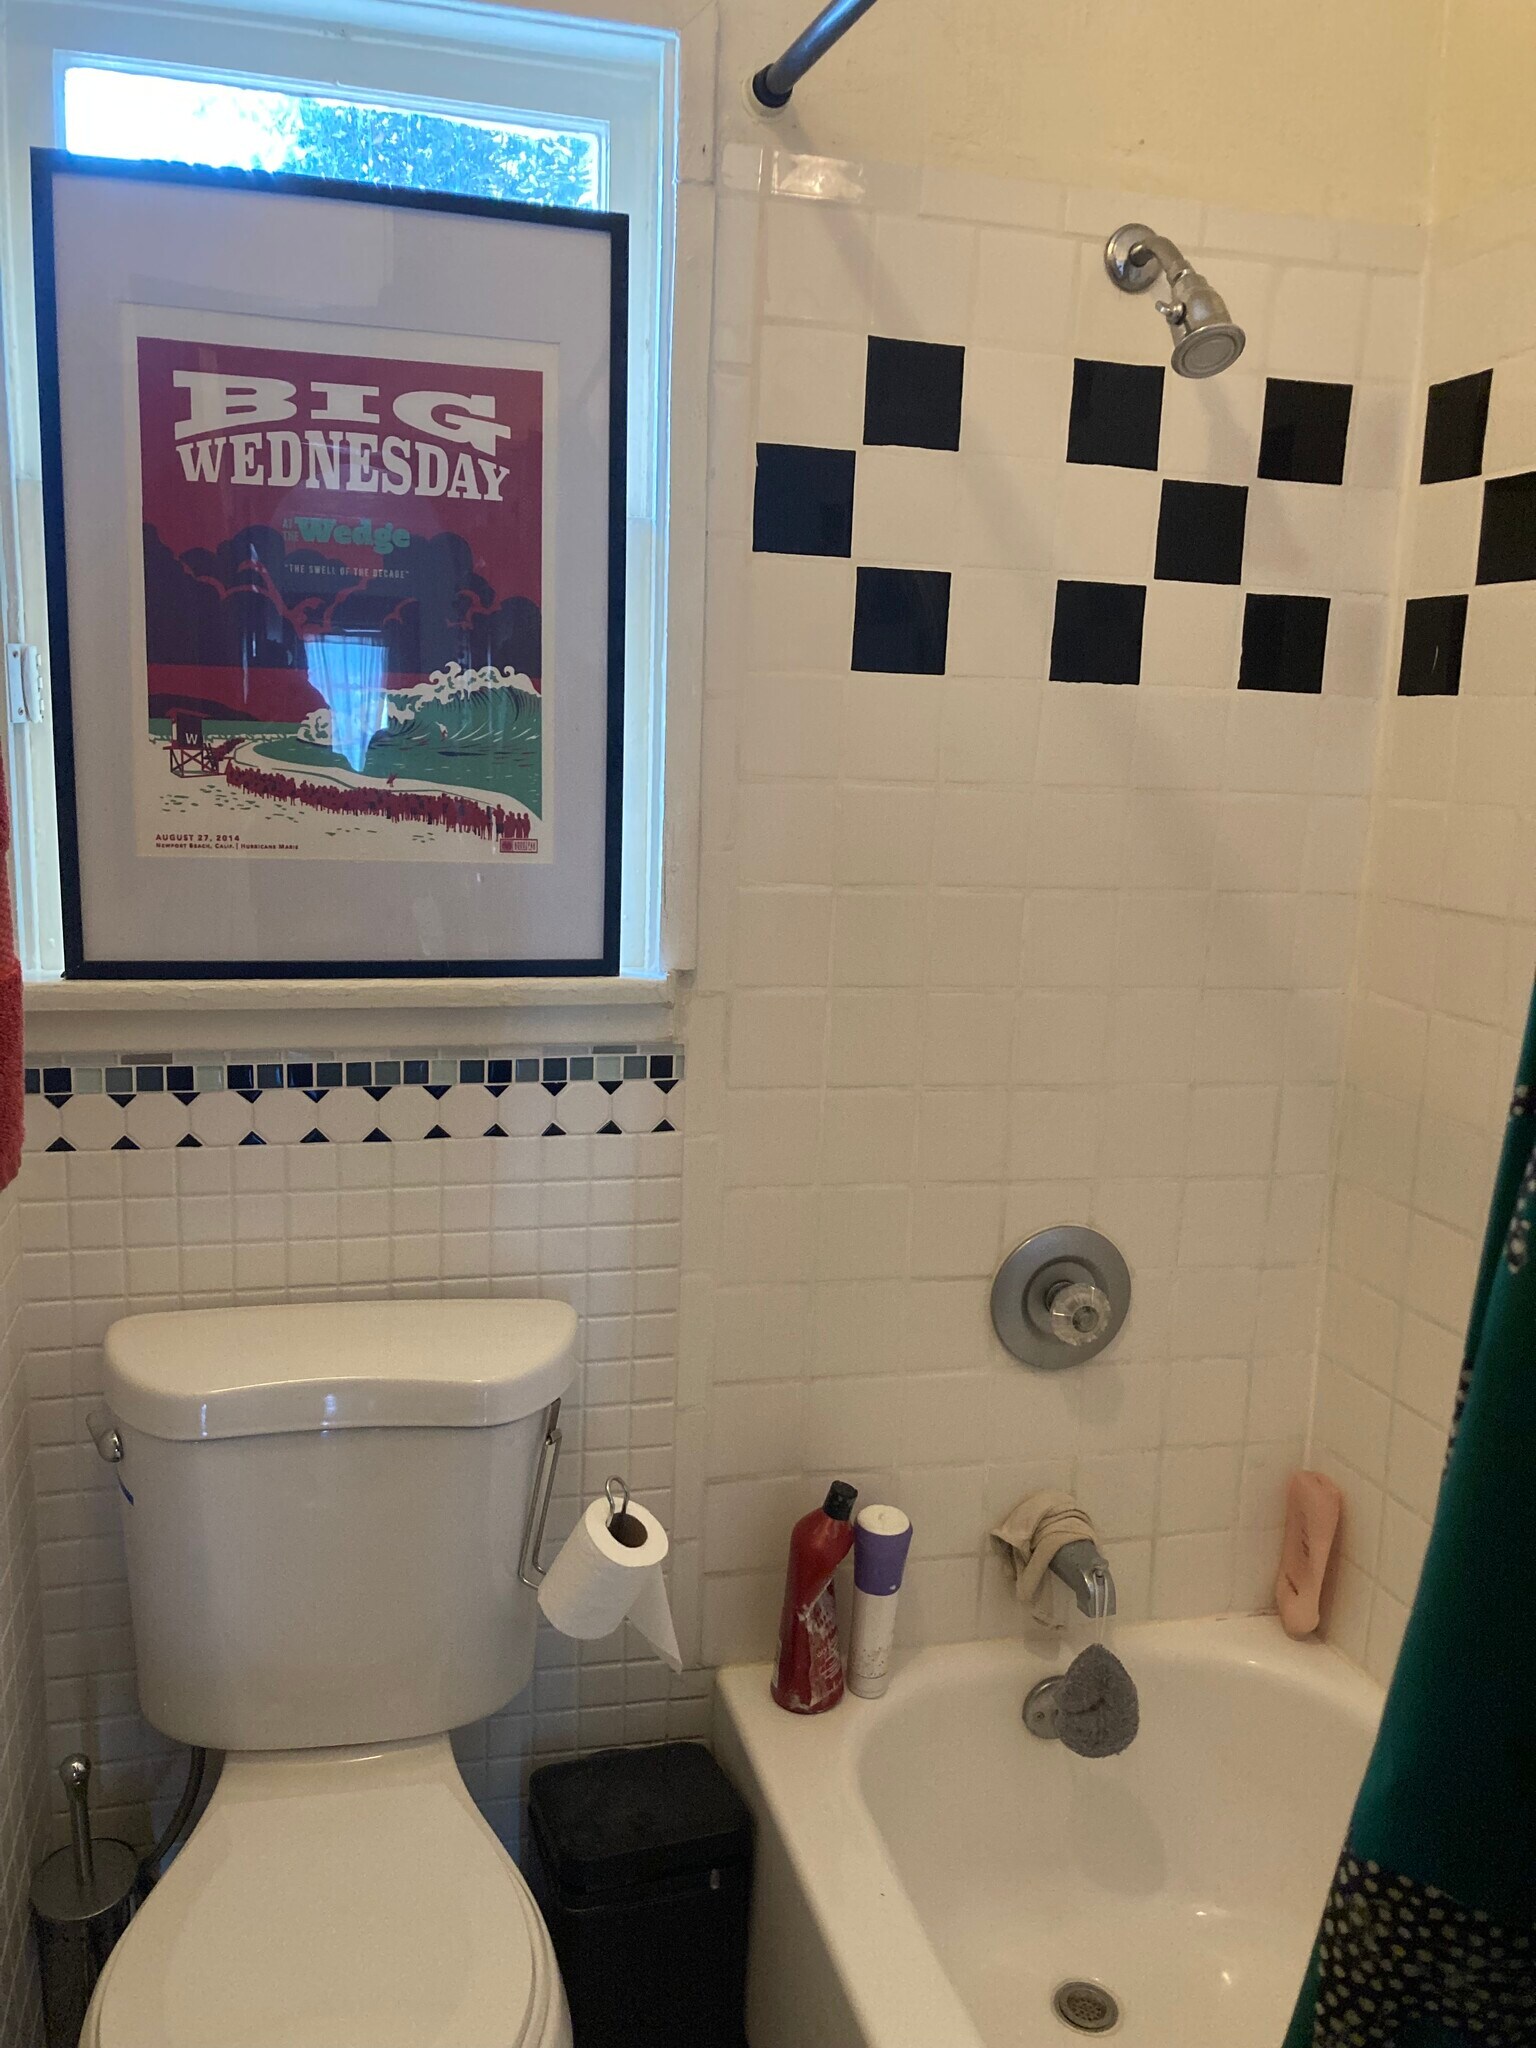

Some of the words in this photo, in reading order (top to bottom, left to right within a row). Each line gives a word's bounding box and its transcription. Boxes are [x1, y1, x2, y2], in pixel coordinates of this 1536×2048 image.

[173, 370, 511, 456] BIG
[176, 430, 510, 501] WEDNESDAY
[294, 516, 410, 555] Wedge
[308, 565, 336, 575] SWELL
[339, 567, 350, 576] OF
[353, 567, 369, 577] THE
[185, 732, 198, 745] W
[155, 833, 194, 842] AUGUST
[197, 834, 213, 842] 27,
[216, 834, 240, 842] 2014
